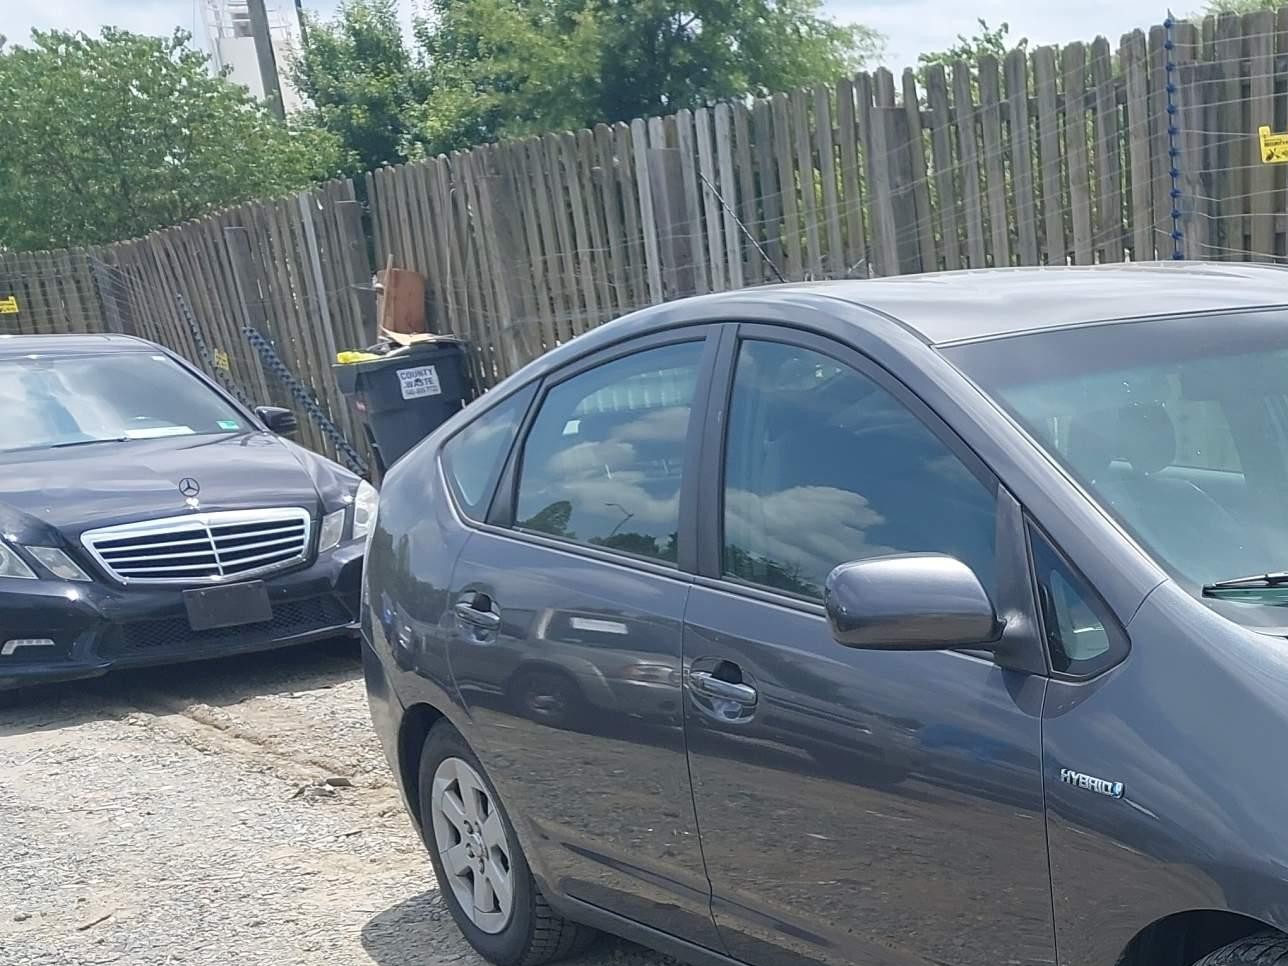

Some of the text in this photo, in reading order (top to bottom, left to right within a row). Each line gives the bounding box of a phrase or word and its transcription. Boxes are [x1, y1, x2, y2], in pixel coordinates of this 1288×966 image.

[400, 368, 433, 380] COUNTY
[403, 377, 434, 388] WASTE
[1060, 768, 1113, 796] HYBRID
